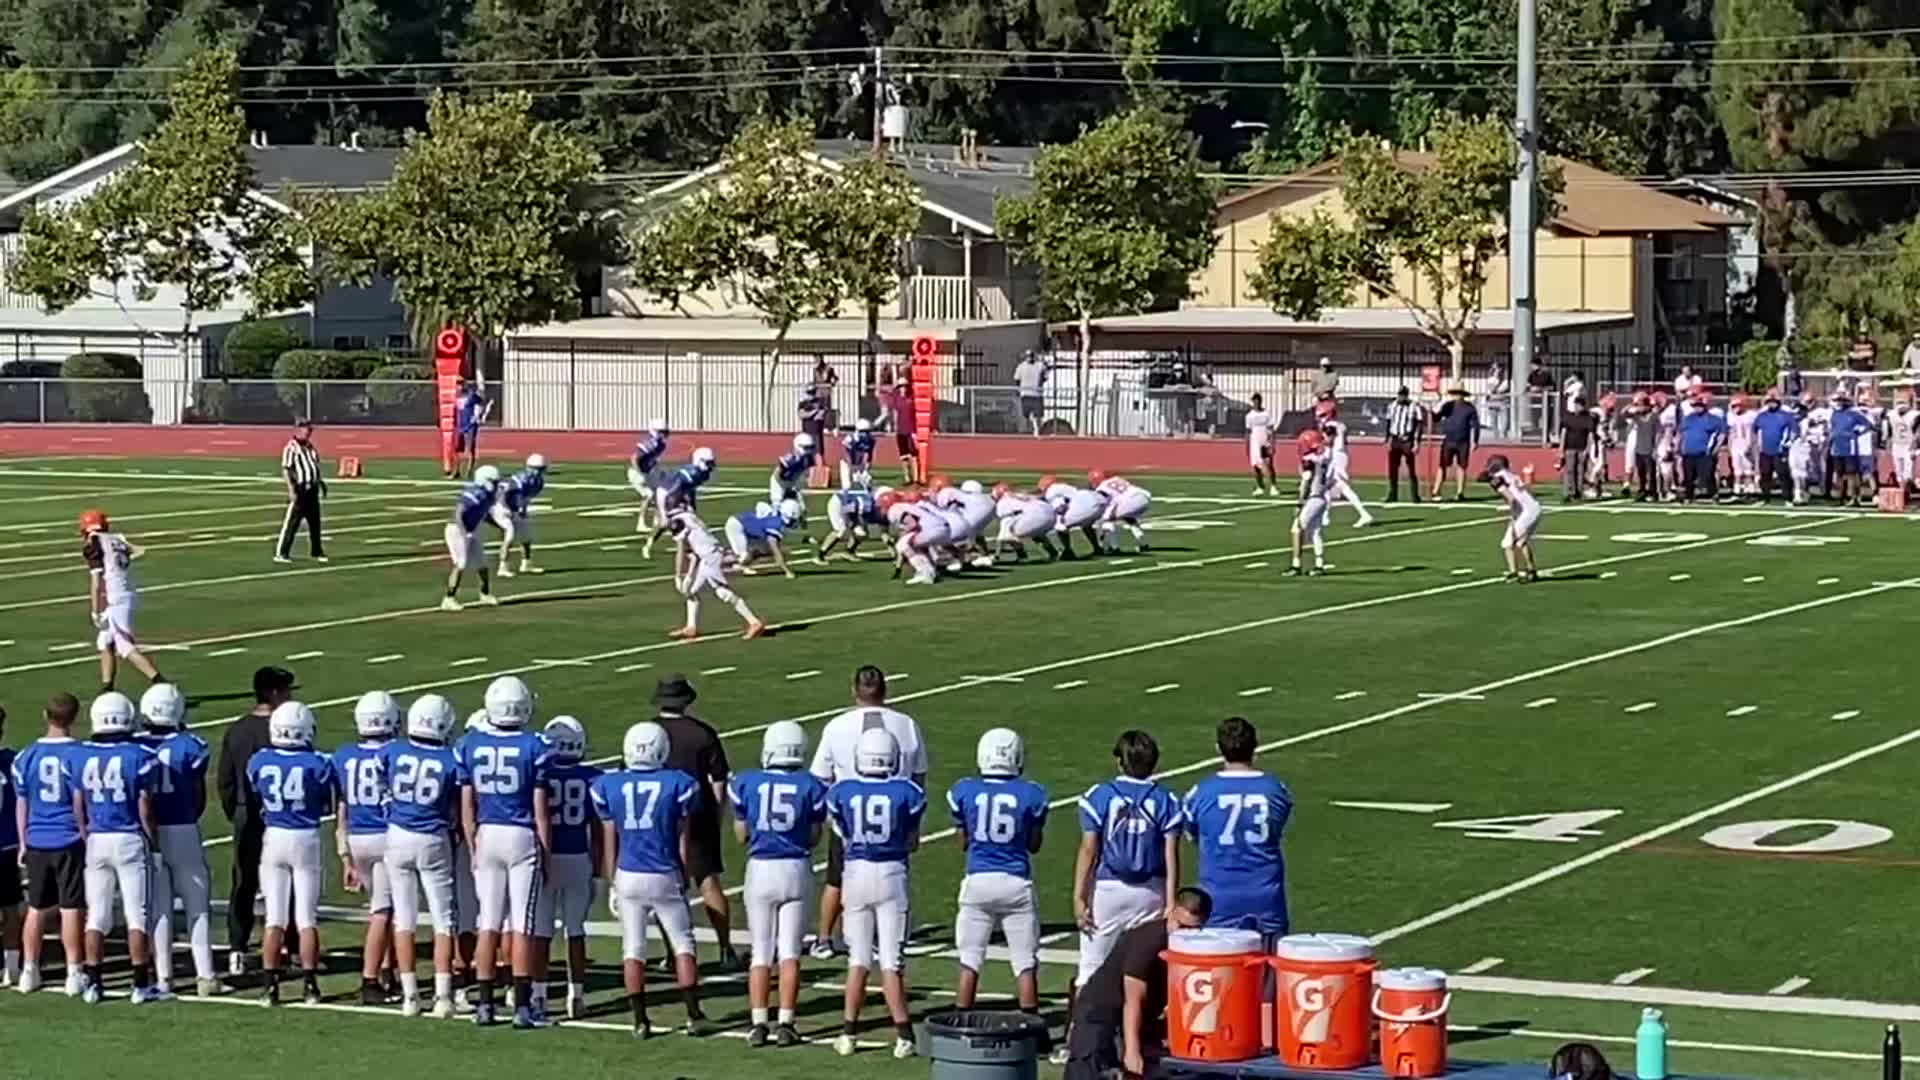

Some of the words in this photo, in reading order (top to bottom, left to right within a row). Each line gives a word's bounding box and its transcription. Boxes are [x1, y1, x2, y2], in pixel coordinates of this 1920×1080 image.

[39, 756, 60, 802] 9
[82, 756, 126, 802] 44
[259, 764, 305, 812] 34
[344, 757, 381, 806] 18
[392, 754, 443, 805] 26
[473, 746, 520, 795] 25
[622, 781, 661, 829] 17
[755, 783, 798, 832] 15
[849, 794, 891, 844] 19
[974, 792, 1018, 843] 16
[1217, 793, 1269, 845] 73
[1185, 971, 1213, 1003] G
[1295, 979, 1324, 1012] G
